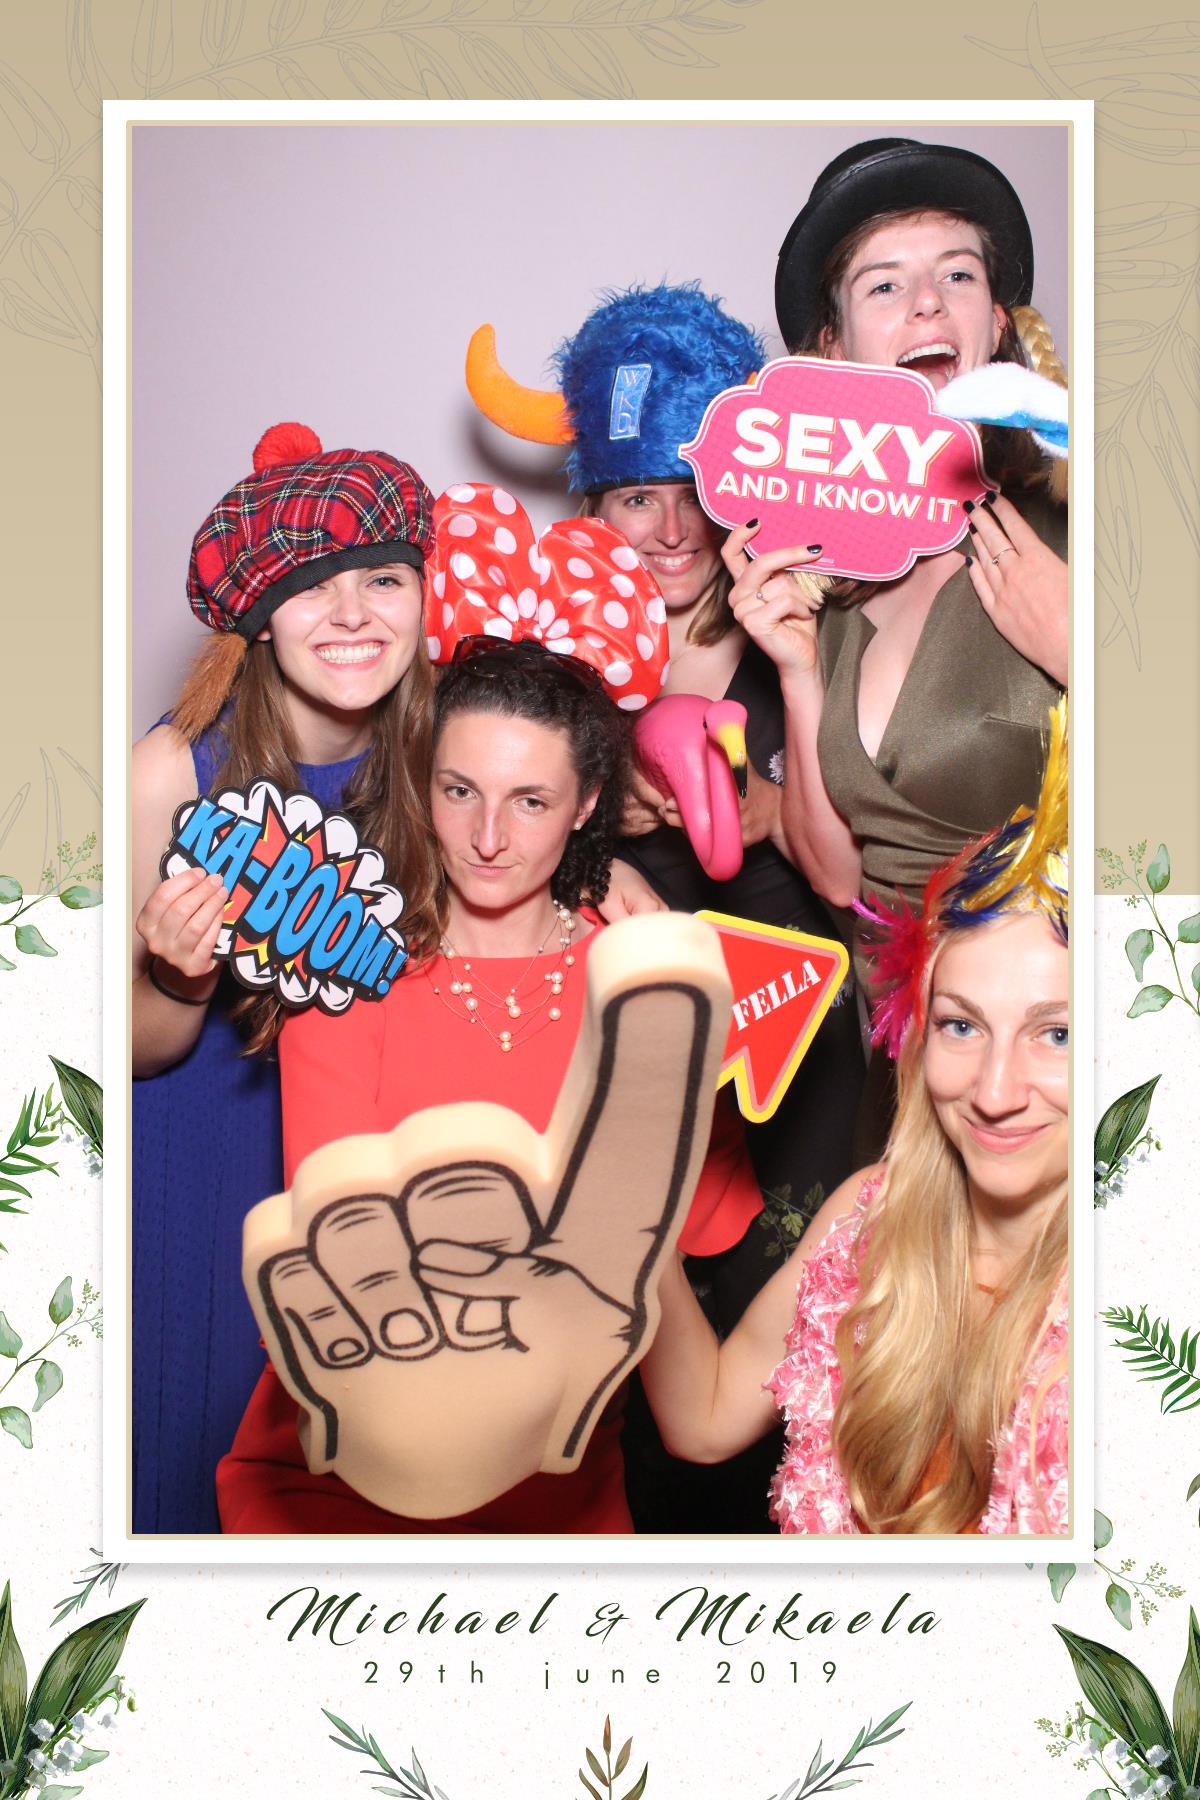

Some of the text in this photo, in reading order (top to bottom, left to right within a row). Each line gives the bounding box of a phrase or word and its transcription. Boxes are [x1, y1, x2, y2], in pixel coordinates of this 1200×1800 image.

[732, 408, 956, 487] SEXY
[715, 471, 958, 523] AND I KNOW IT
[731, 959, 821, 1031] FELLA
